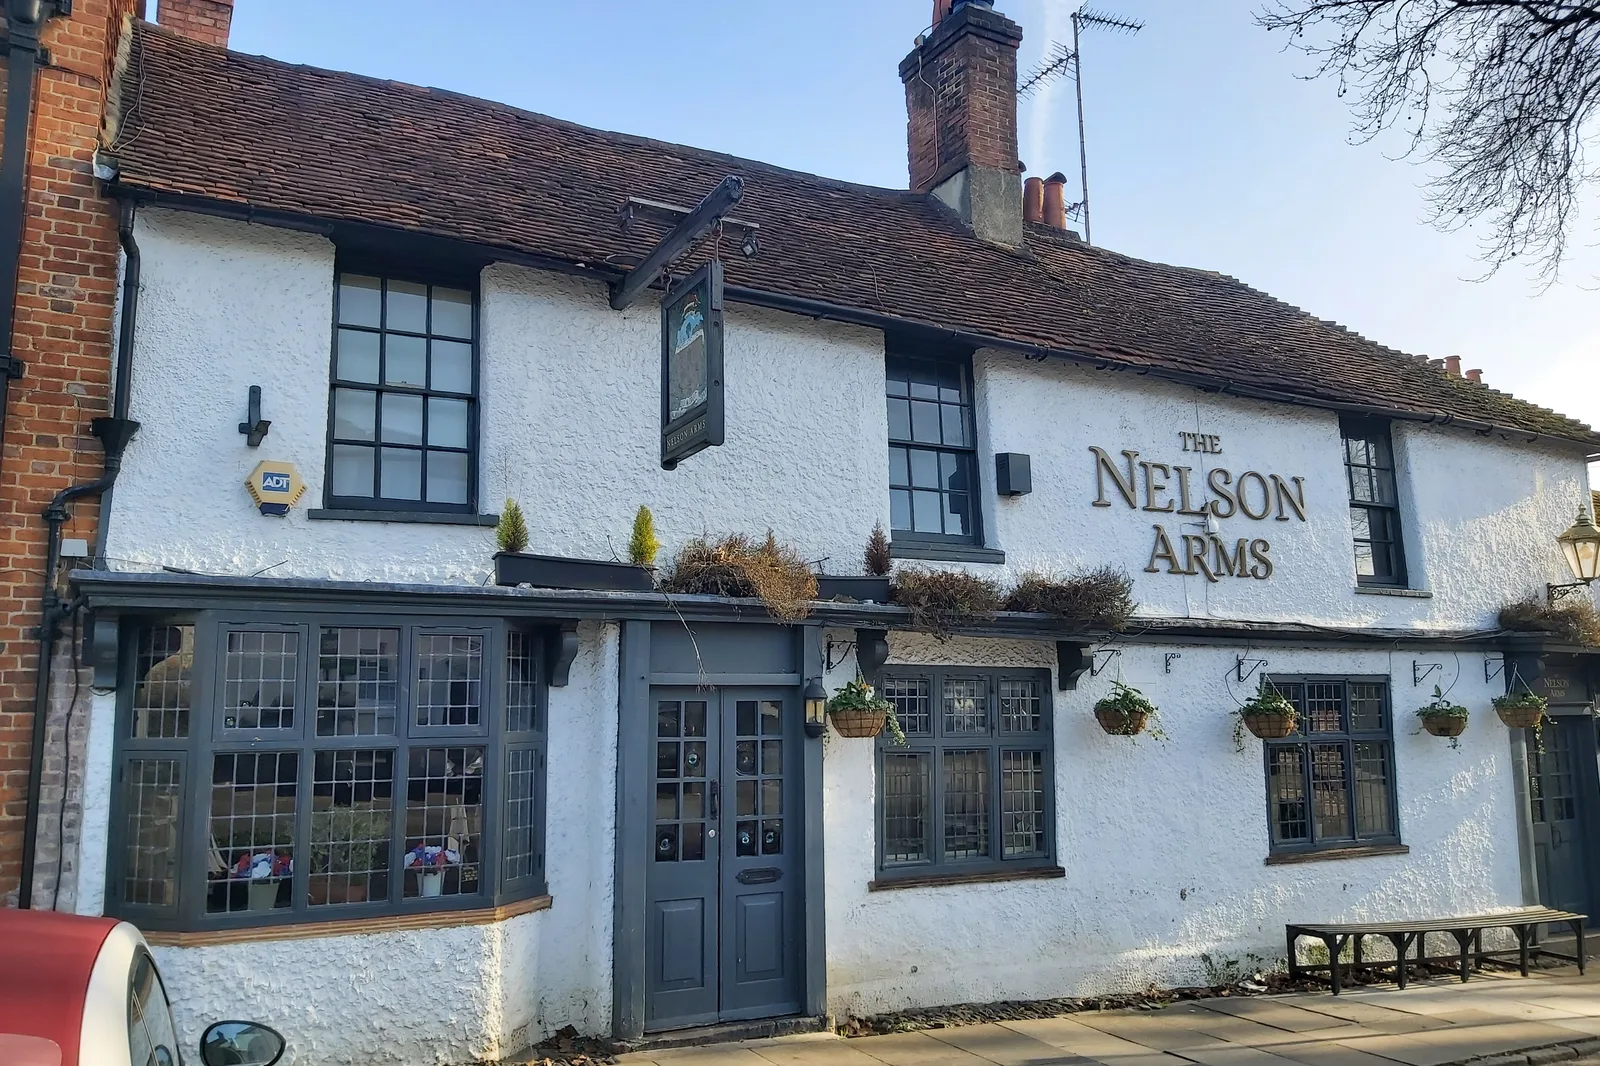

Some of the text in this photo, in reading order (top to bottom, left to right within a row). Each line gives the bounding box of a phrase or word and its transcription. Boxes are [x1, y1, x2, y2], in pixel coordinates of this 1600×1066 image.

[666, 420, 706, 449] NELSON ARMS
[1178, 430, 1222, 454] THE
[262, 476, 290, 488] ADT
[1088, 445, 1306, 522] NELSON
[1143, 523, 1273, 582] ARMS
[1543, 677, 1570, 688] NELSON
